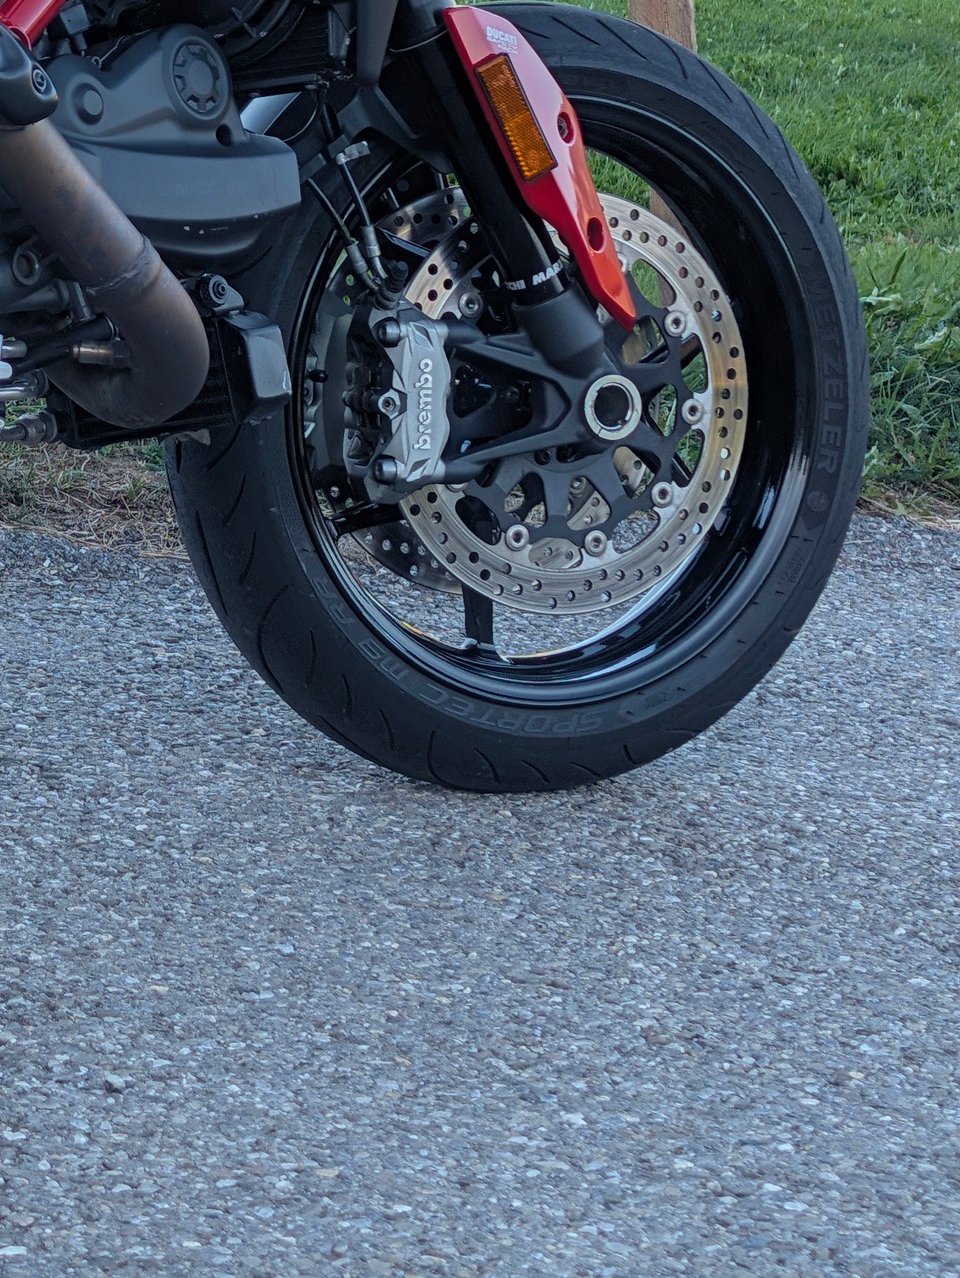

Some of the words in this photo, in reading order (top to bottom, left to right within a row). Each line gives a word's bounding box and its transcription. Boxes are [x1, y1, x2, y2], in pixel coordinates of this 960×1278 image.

[486, 25, 517, 45] DUCATI
[413, 358, 433, 450] brembo
[806, 283, 844, 474] METZELER
[418, 683, 609, 733] SPORTEC
